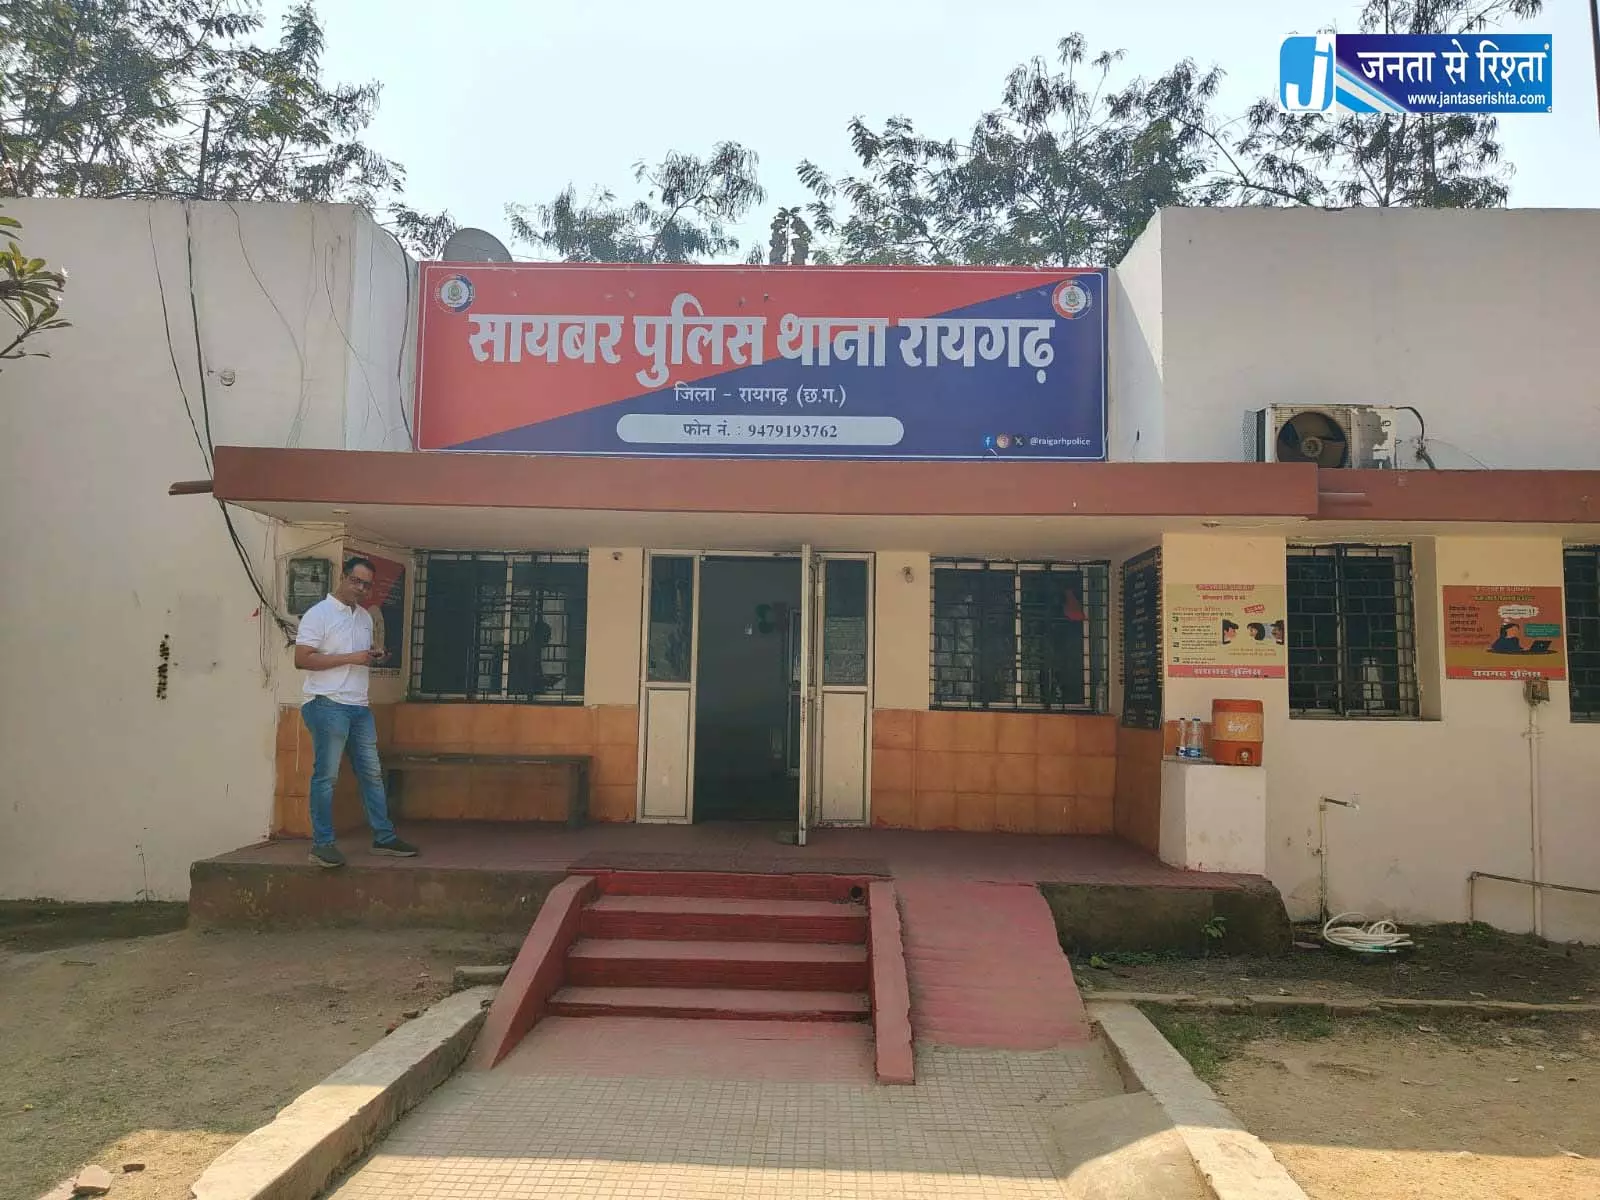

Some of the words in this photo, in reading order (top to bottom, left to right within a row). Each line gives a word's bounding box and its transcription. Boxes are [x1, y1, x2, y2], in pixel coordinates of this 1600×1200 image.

[468, 313, 625, 364] सायबर
[632, 292, 767, 388] पुलिस
[776, 312, 889, 367] थाना
[897, 317, 1056, 384] रायगढ़
[674, 382, 717, 402] जिला
[738, 386, 788, 406] रायगढ़
[796, 384, 847, 408] (छ.ग.)
[682, 419, 711, 436] फोन
[747, 425, 838, 439] 9479193762
[1029, 437, 1091, 446] @raigarhpolice
